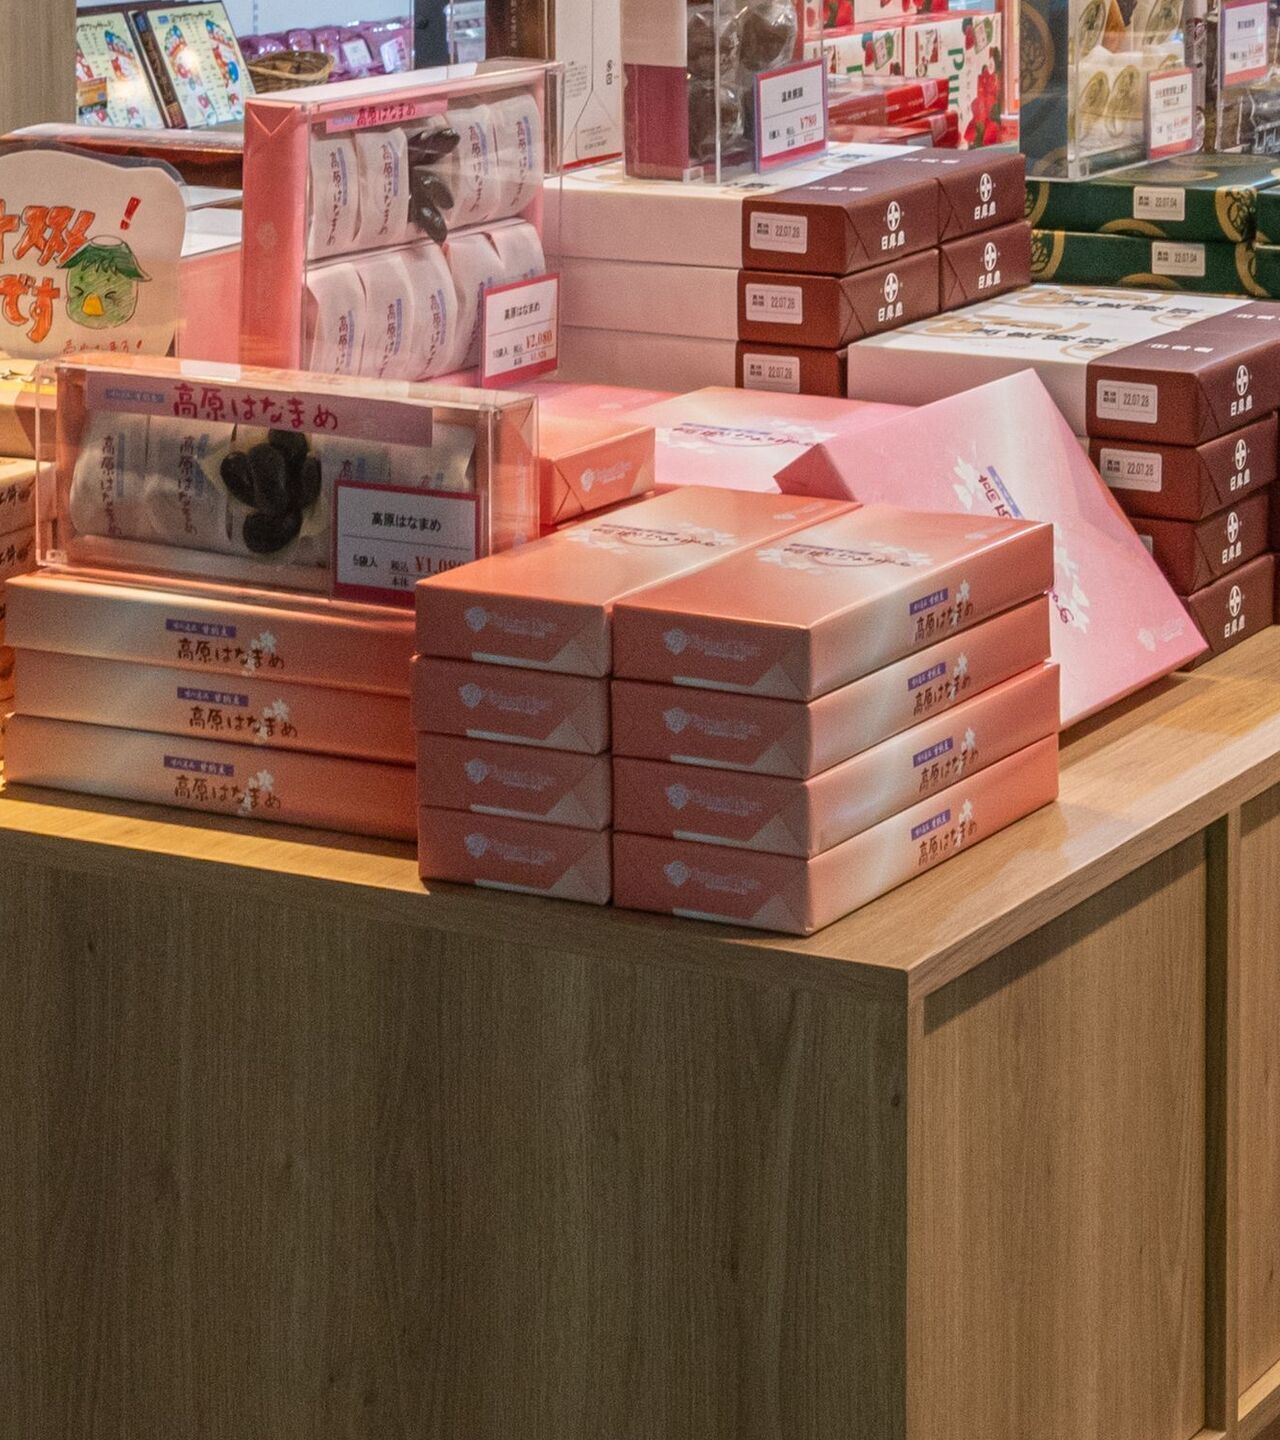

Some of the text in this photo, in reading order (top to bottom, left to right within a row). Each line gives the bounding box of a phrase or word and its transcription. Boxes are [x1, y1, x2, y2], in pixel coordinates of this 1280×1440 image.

[356, 103, 418, 128] 高原はなまめ
[503, 302, 542, 321] 高原はなまめ
[525, 329, 554, 351] ¥2,080
[172, 383, 340, 432] 高原はなまめ
[371, 510, 442, 533] 高原はなまめ
[414, 555, 466, 576] ¥1,08
[178, 637, 285, 670] 高原はなまめ
[189, 706, 298, 738] 高原はなまめ
[174, 775, 281, 810] 高原はなまめ
